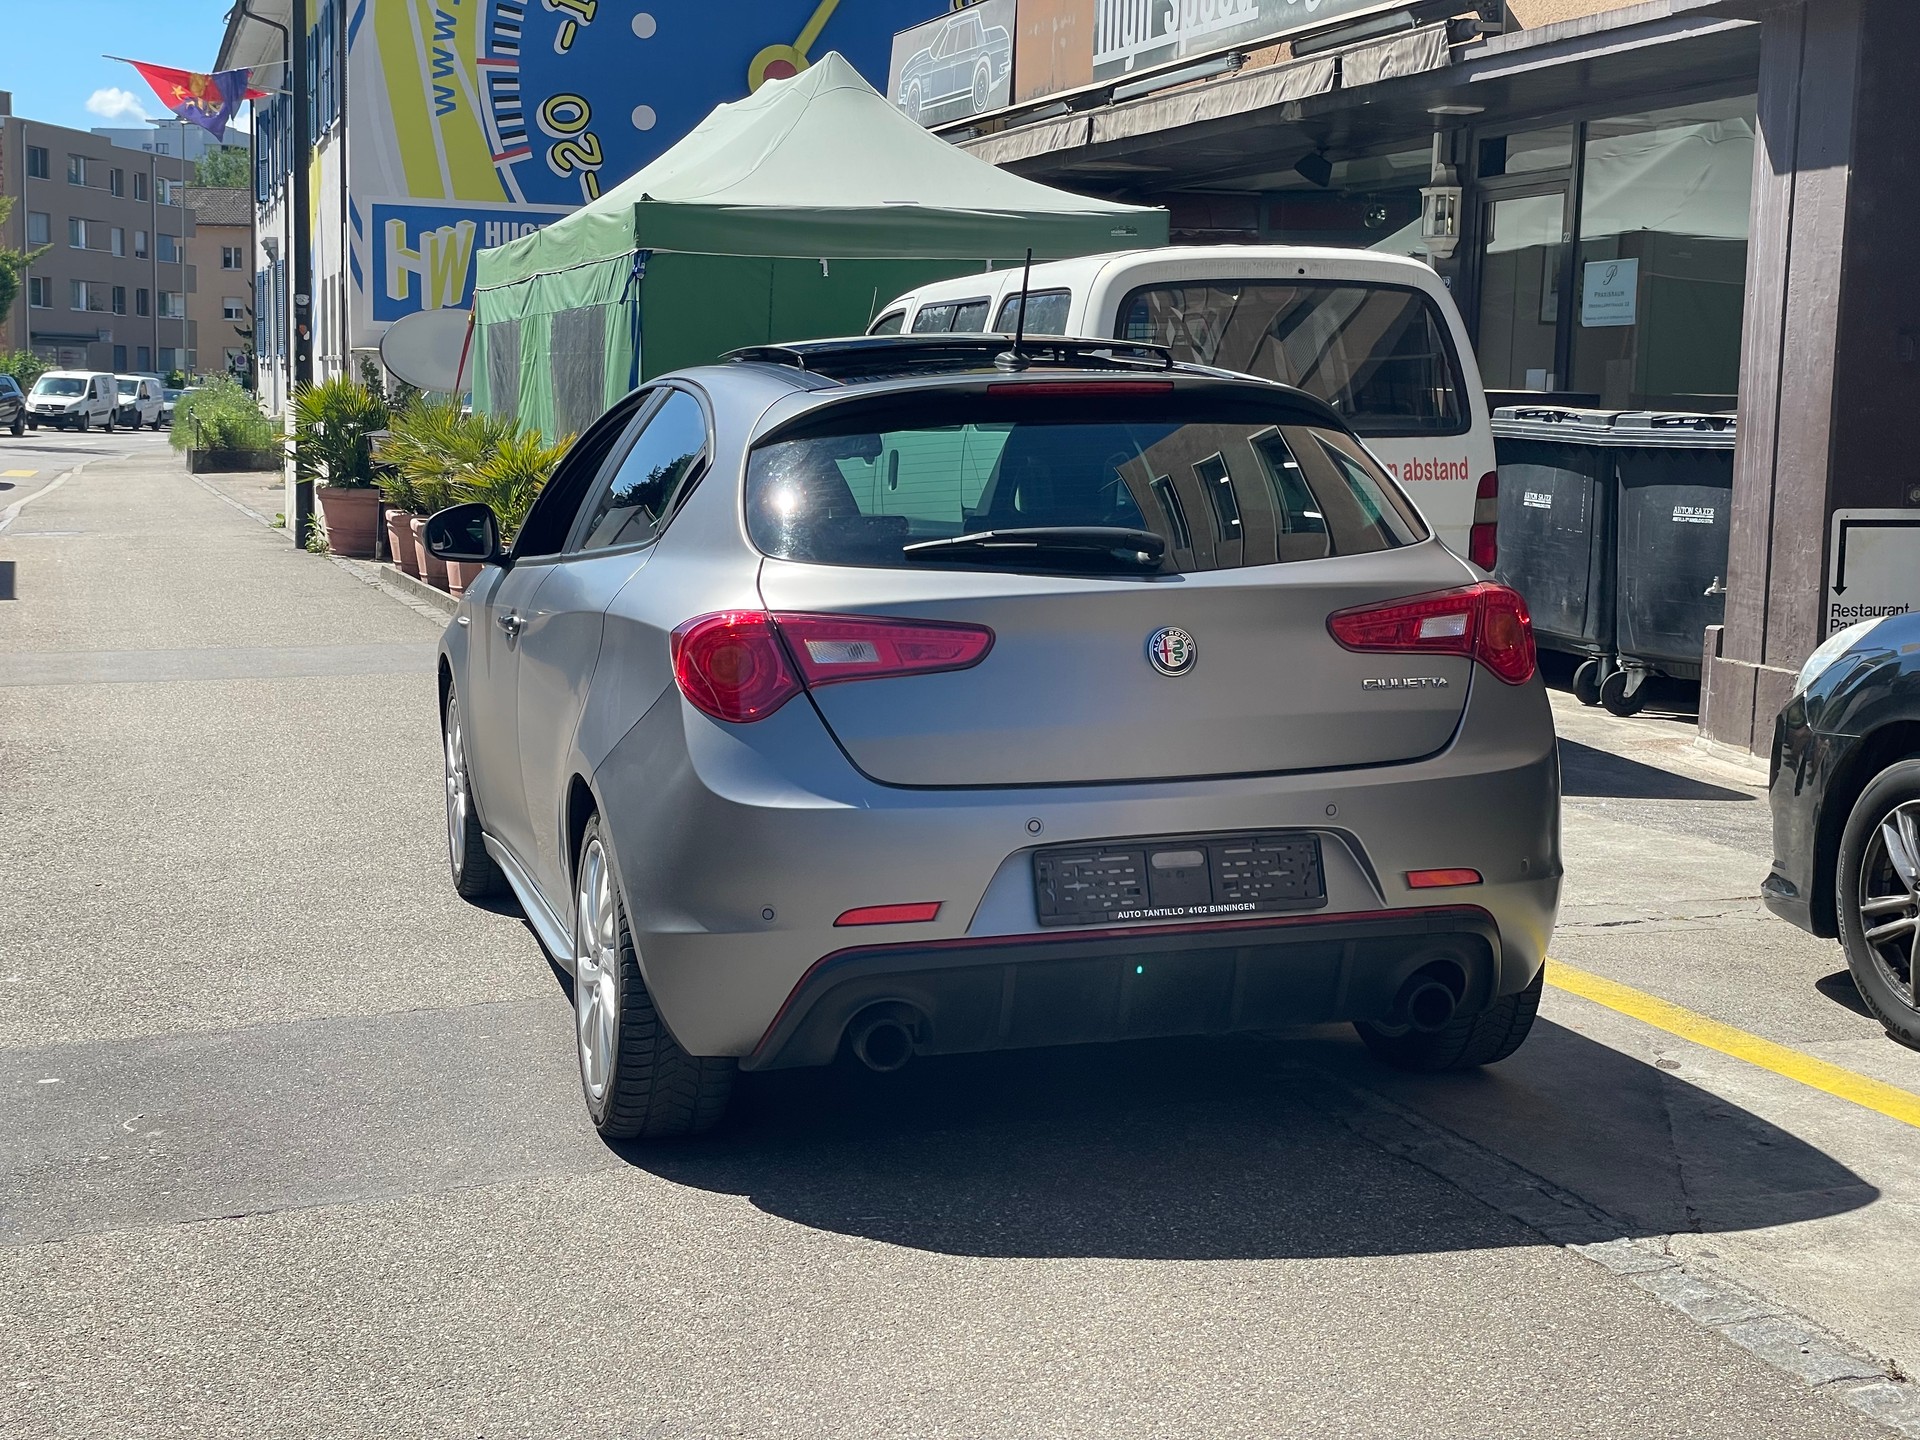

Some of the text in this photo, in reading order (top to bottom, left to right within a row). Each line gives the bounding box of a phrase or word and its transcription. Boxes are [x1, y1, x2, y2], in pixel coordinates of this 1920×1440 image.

[1403, 456, 1469, 481] abstand
[1673, 505, 1715, 516] ANTON SAXER
[1831, 603, 1910, 618] Restaurant
[1153, 630, 1193, 653] ALFA ROMEO
[1362, 677, 1449, 691] GIULIETTA
[1117, 902, 1256, 919] AUTO TANTILLO 4102 BINNINGEN
